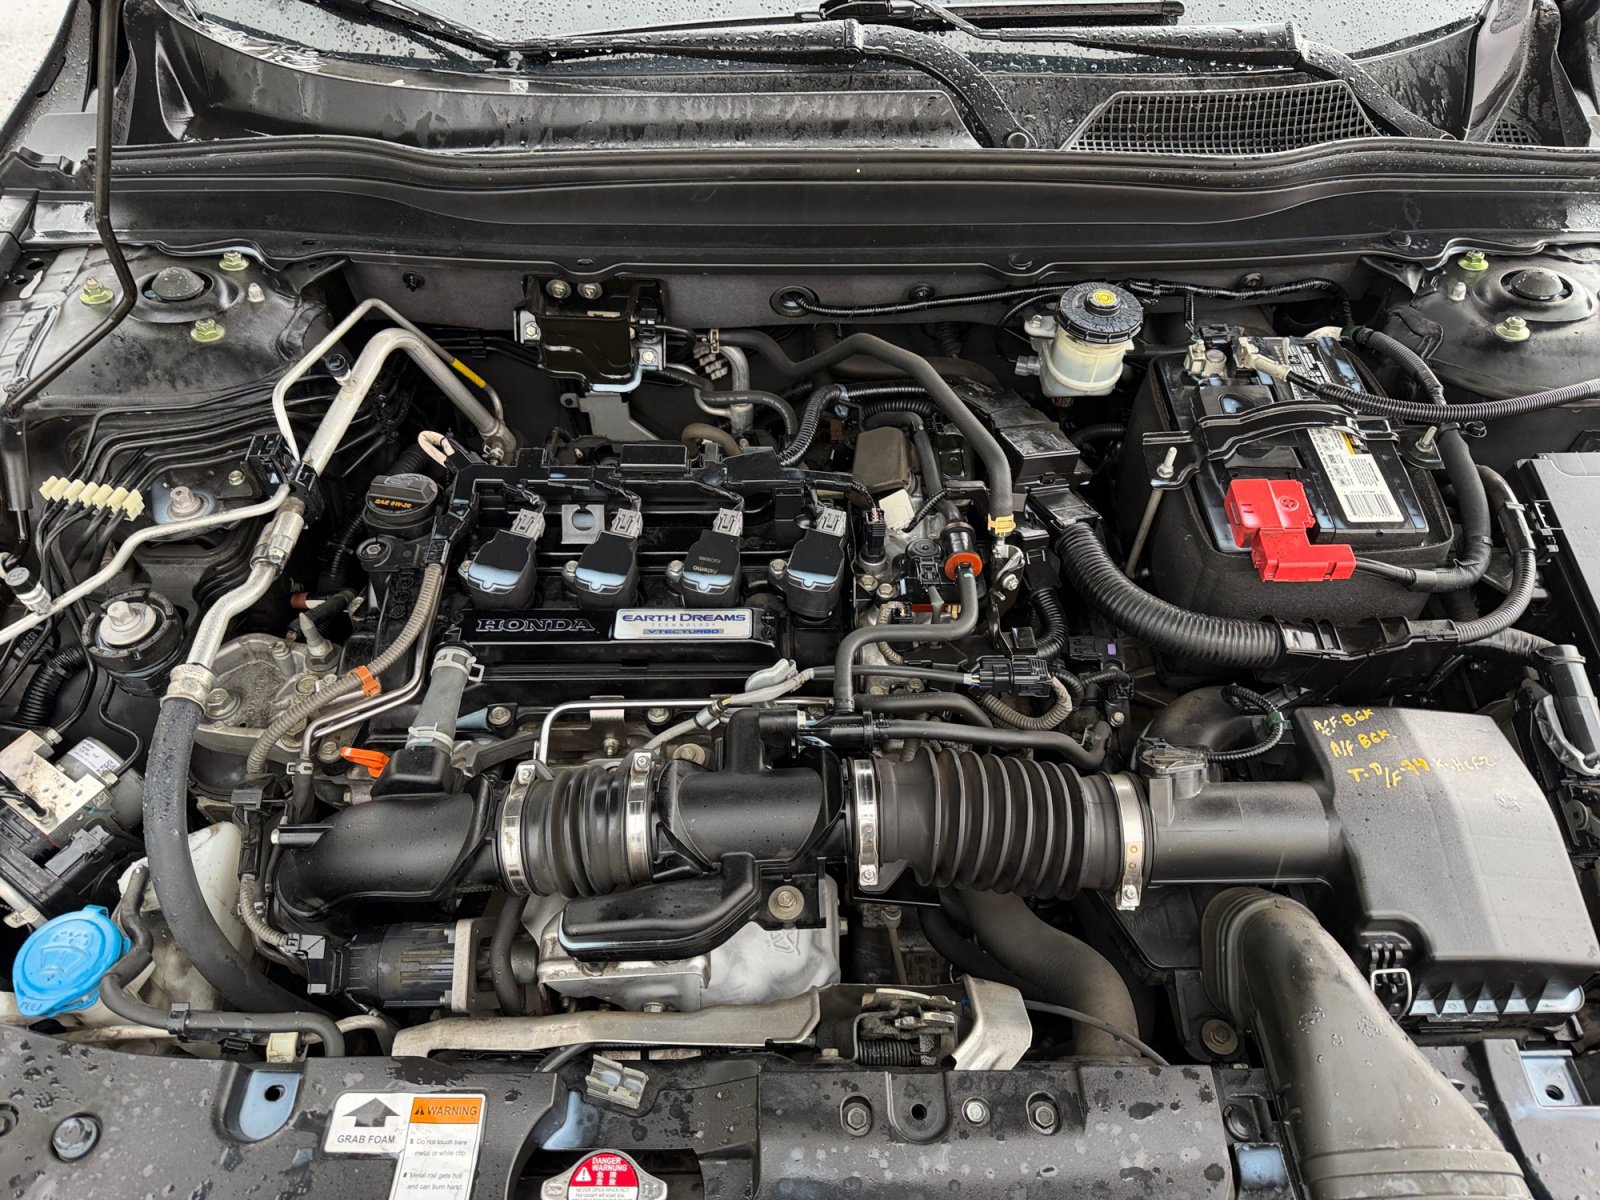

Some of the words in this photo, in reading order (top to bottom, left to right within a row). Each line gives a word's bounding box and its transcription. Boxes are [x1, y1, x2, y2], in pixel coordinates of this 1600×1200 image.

[680, 613, 746, 622] DREAMS
[475, 618, 596, 632] HONDA
[427, 1106, 478, 1116] WARNING
[337, 1134, 365, 1144] GRAB
[368, 1134, 396, 1144] FOAM
